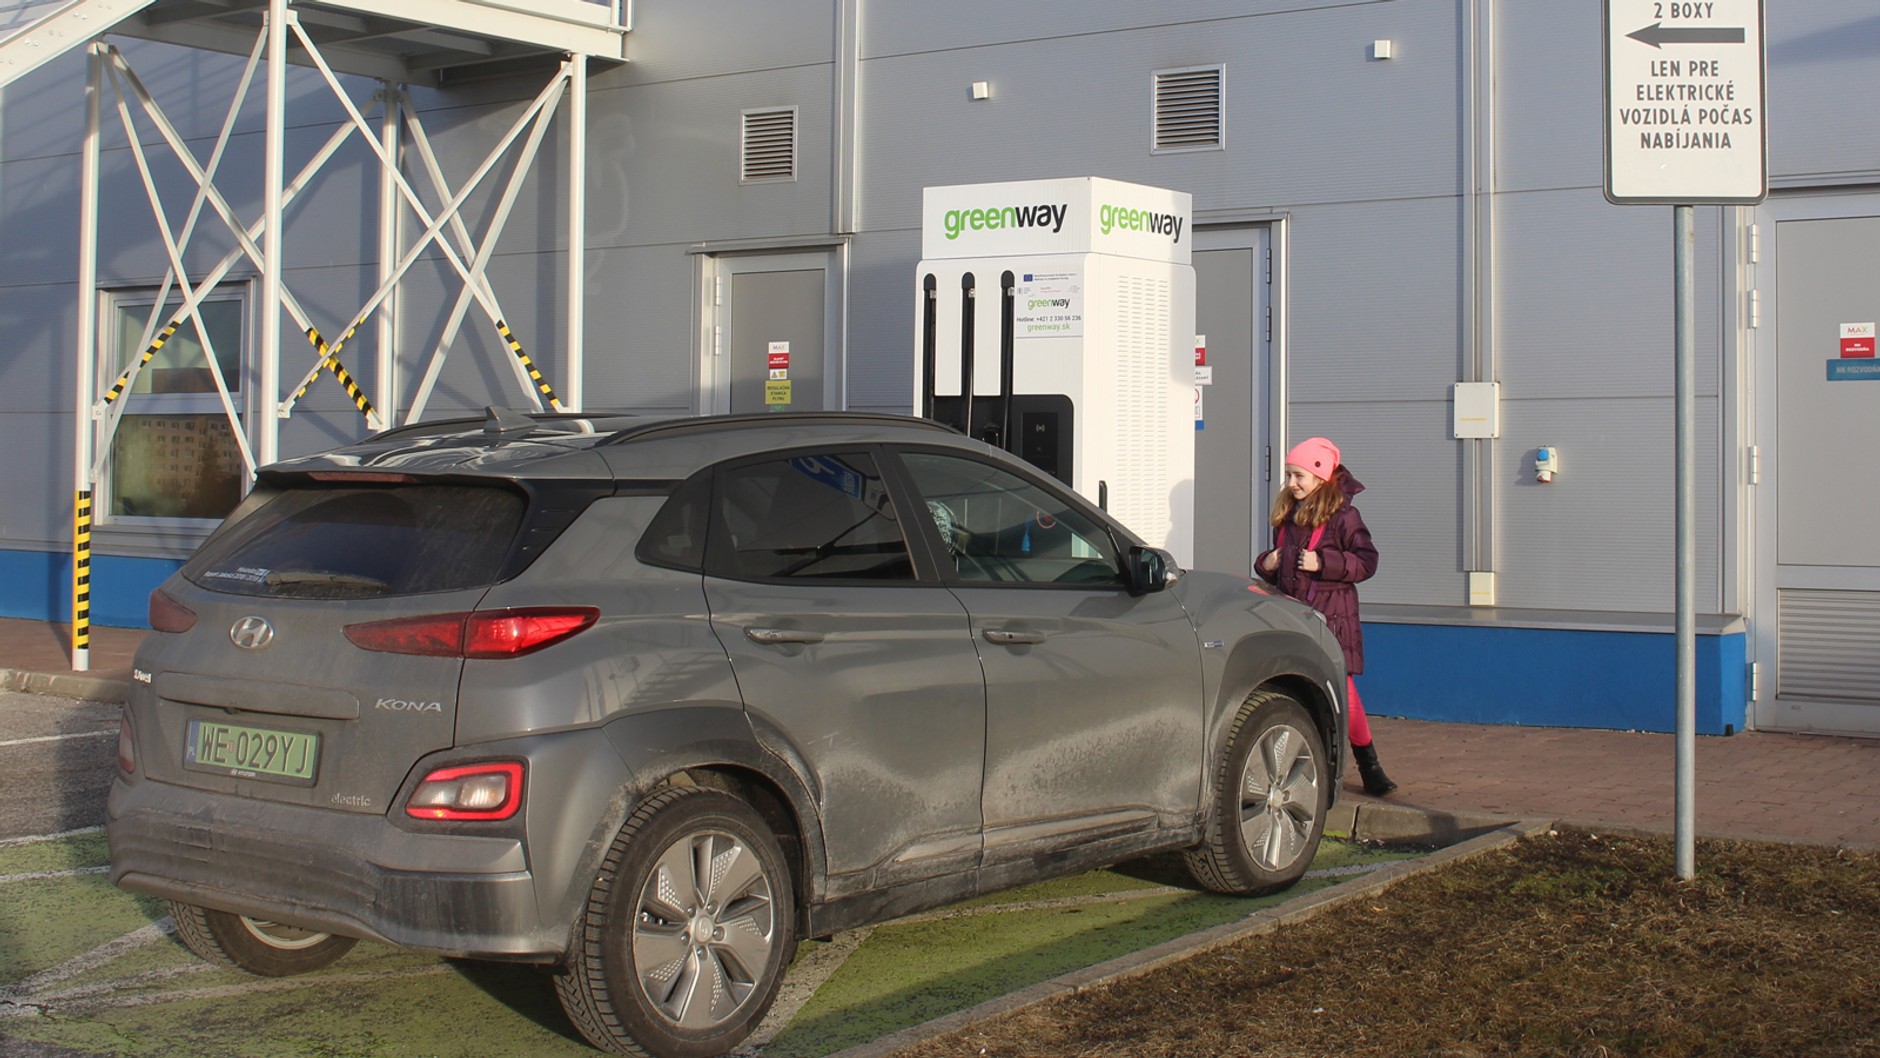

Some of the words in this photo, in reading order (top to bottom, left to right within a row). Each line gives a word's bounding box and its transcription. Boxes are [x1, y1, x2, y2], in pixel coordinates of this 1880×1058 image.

[1654, 3, 1663, 18] 2
[1671, 3, 1714, 18] BOXY
[1651, 60, 1681, 77] LEN
[1689, 60, 1719, 77] PRE
[1636, 80, 1735, 101] ELEKTRICKÉ
[1619, 104, 1691, 125] VOZIDLÁ
[1698, 104, 1753, 125] POČAS
[1640, 128, 1732, 149] NABÍJANIA
[944, 204, 1068, 240] greenway
[1100, 204, 1184, 243] greenway
[1028, 298, 1070, 310] greenway
[1027, 323, 1070, 332] greenway.sk
[375, 698, 442, 713] KONA
[202, 725, 230, 763] WE
[235, 730, 310, 774] 029YJ
[331, 793, 371, 806] electric
